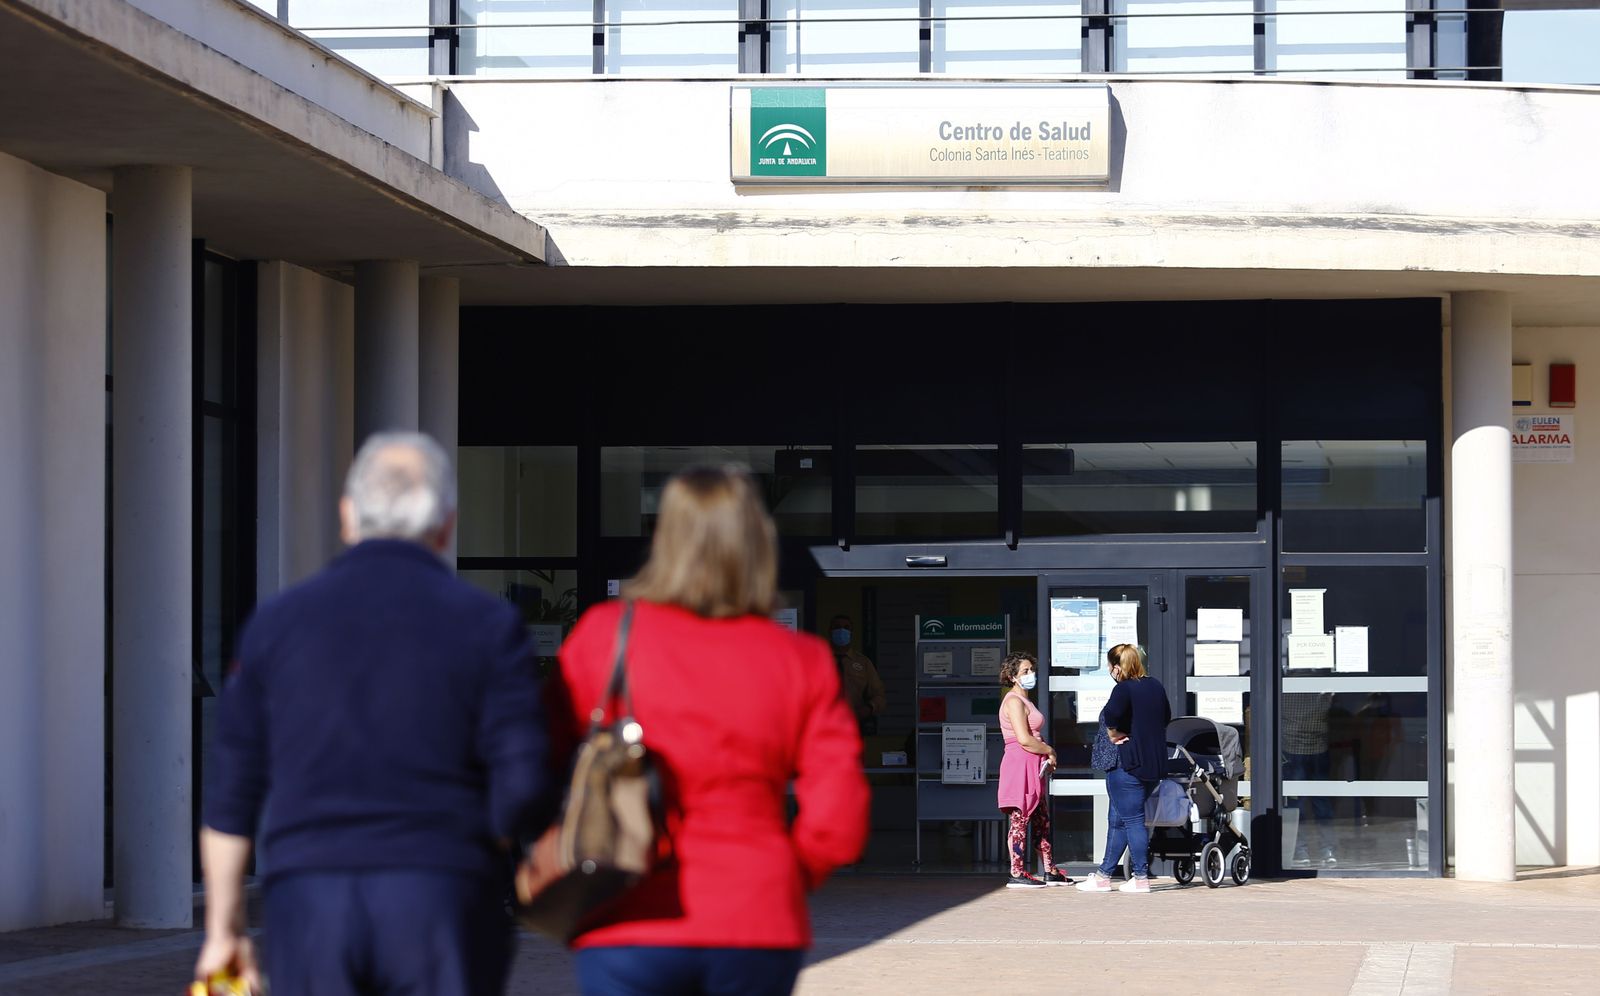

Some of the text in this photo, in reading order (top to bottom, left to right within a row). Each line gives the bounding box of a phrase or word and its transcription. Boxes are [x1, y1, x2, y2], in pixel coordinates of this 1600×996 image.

[938, 120, 1092, 141] Centro de Salud
[929, 147, 972, 162] Colonia
[975, 146, 1008, 161] Santa
[1011, 146, 1035, 161] Inés
[758, 157, 776, 165] JUNTA
[777, 157, 785, 165] DE
[1512, 434, 1570, 444] ALARMA
[953, 622, 1003, 632] Información
